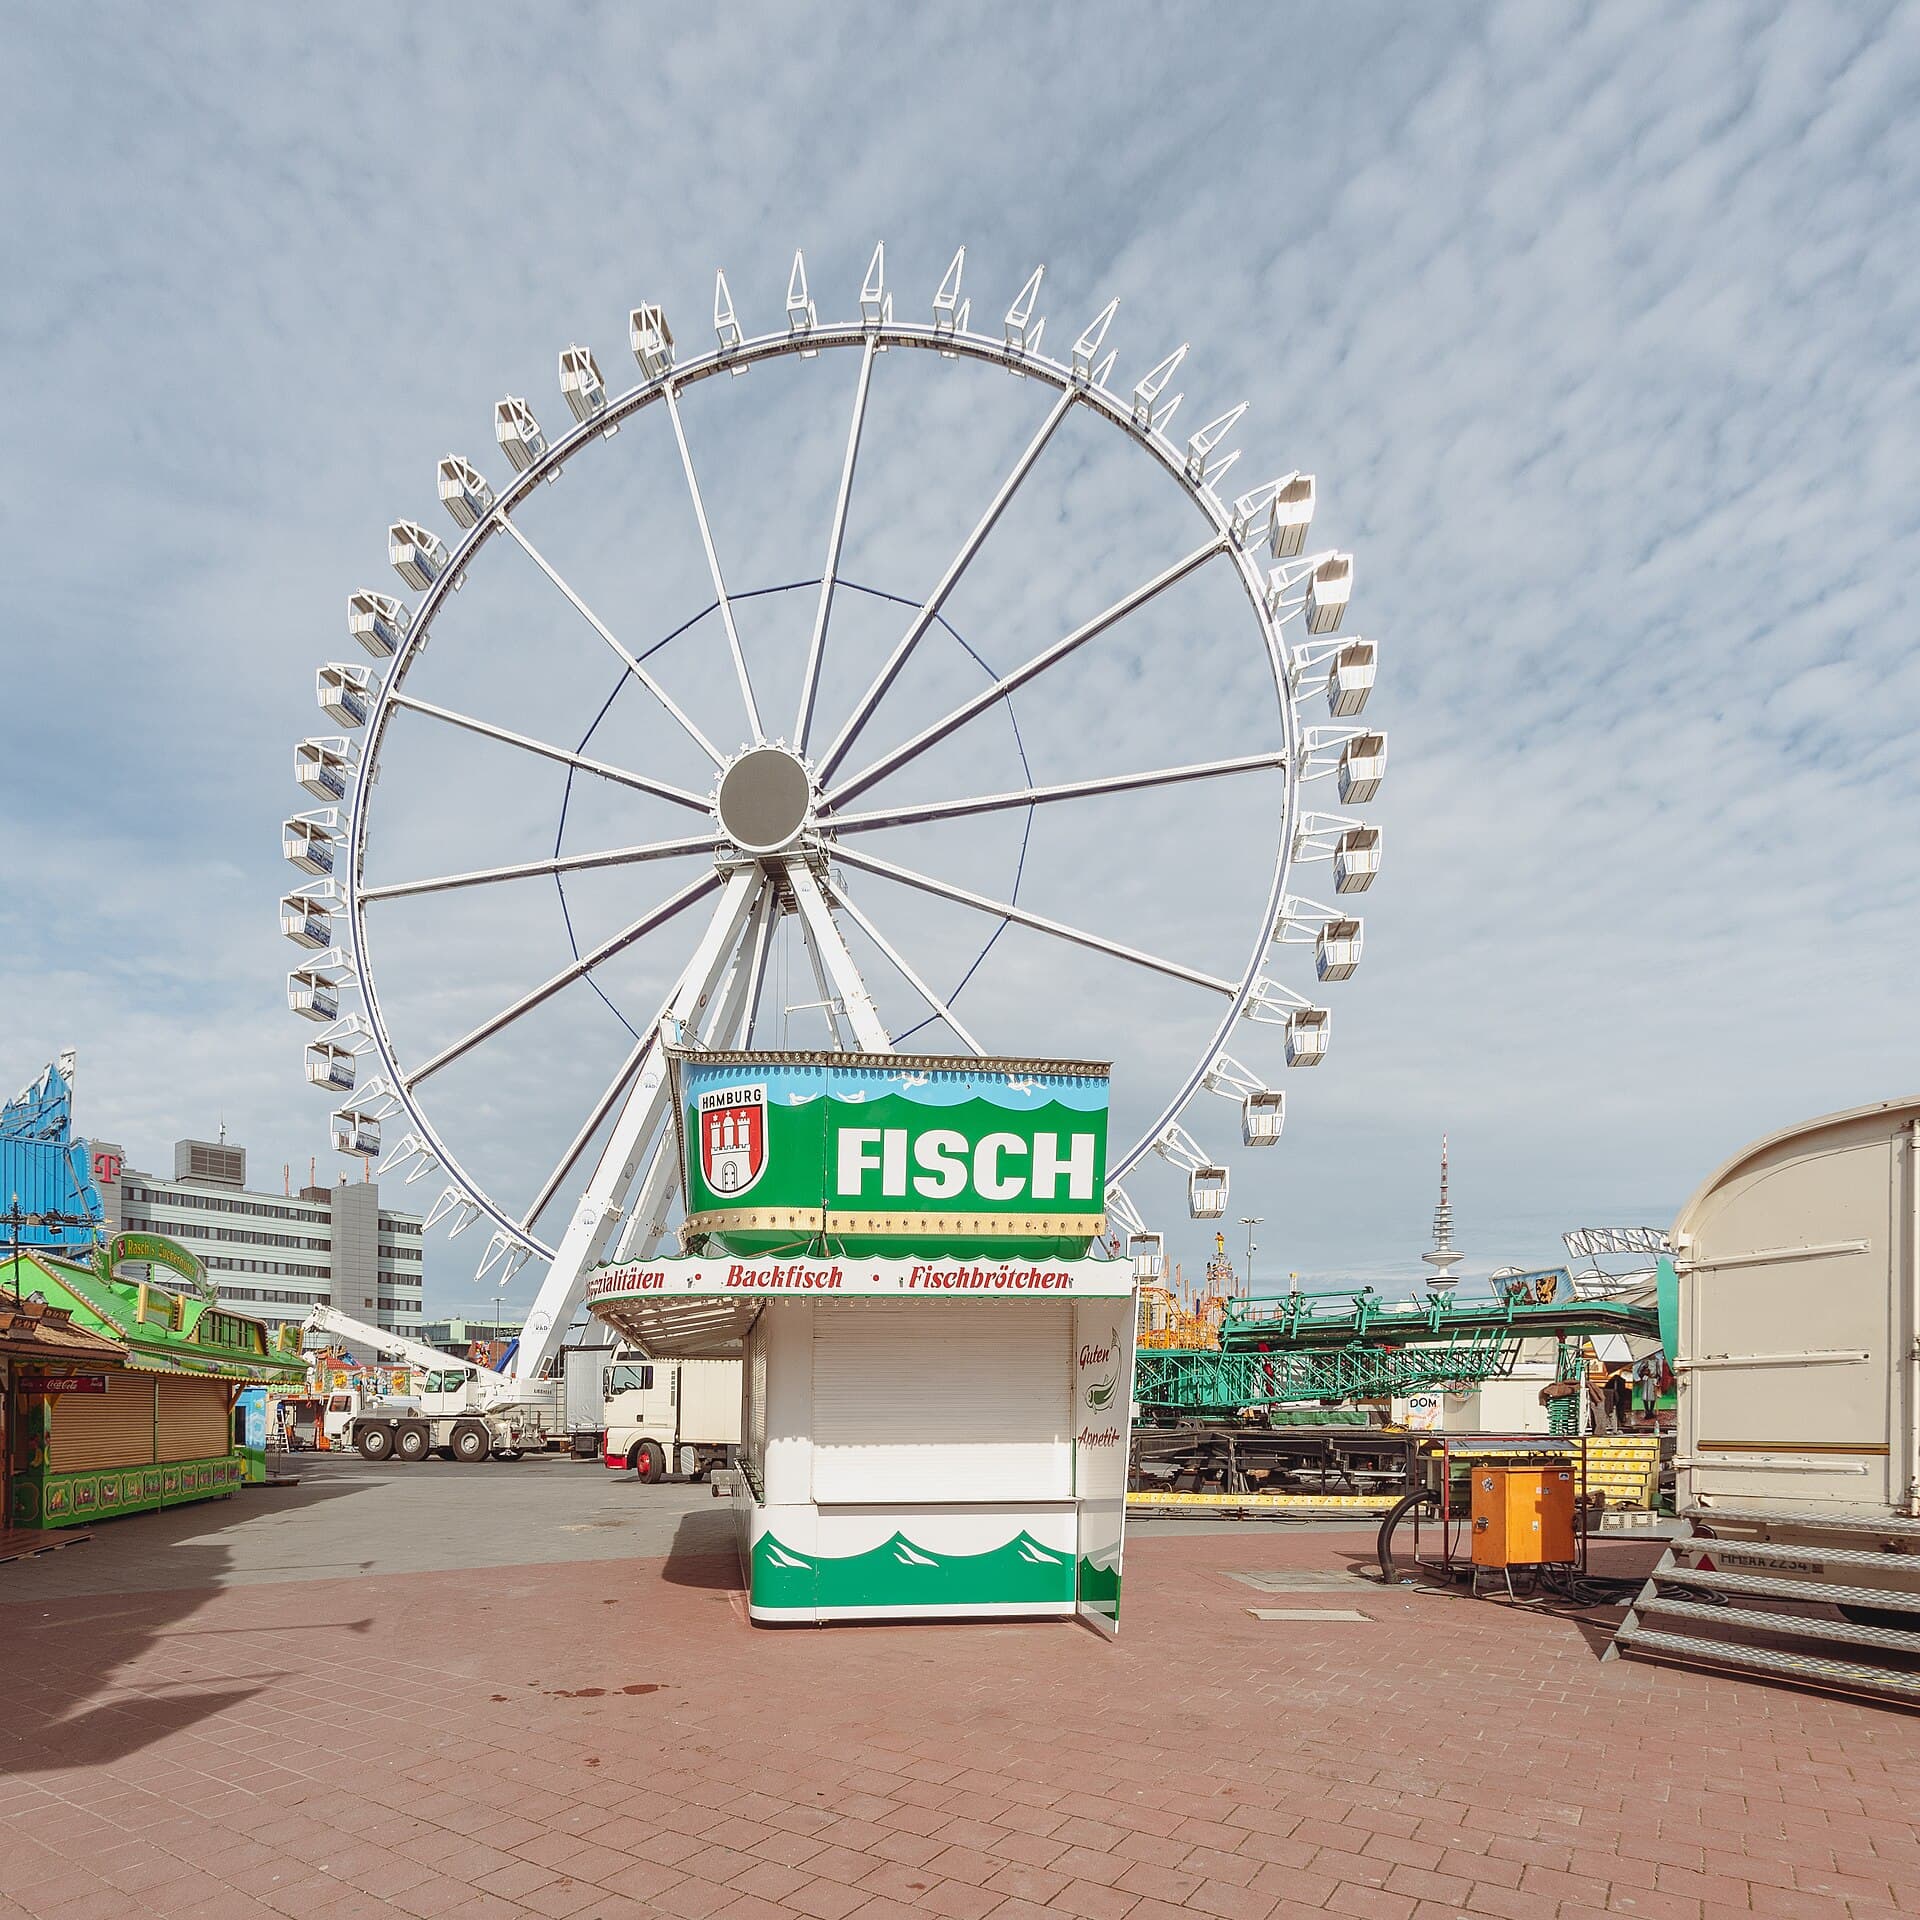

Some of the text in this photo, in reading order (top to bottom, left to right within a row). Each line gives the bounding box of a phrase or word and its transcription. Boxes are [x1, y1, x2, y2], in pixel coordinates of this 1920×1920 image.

[702, 1088, 761, 1110] HAMBURG
[94, 1152, 121, 1184] T
[837, 1127, 1095, 1200] FISCH
[726, 1265, 843, 1288] Backfisch
[908, 1264, 1069, 1288] Fischbrötchen
[1079, 1344, 1110, 1370] Guten
[1410, 1397, 1437, 1408] DOM
[1077, 1426, 1120, 1450] Appetit
